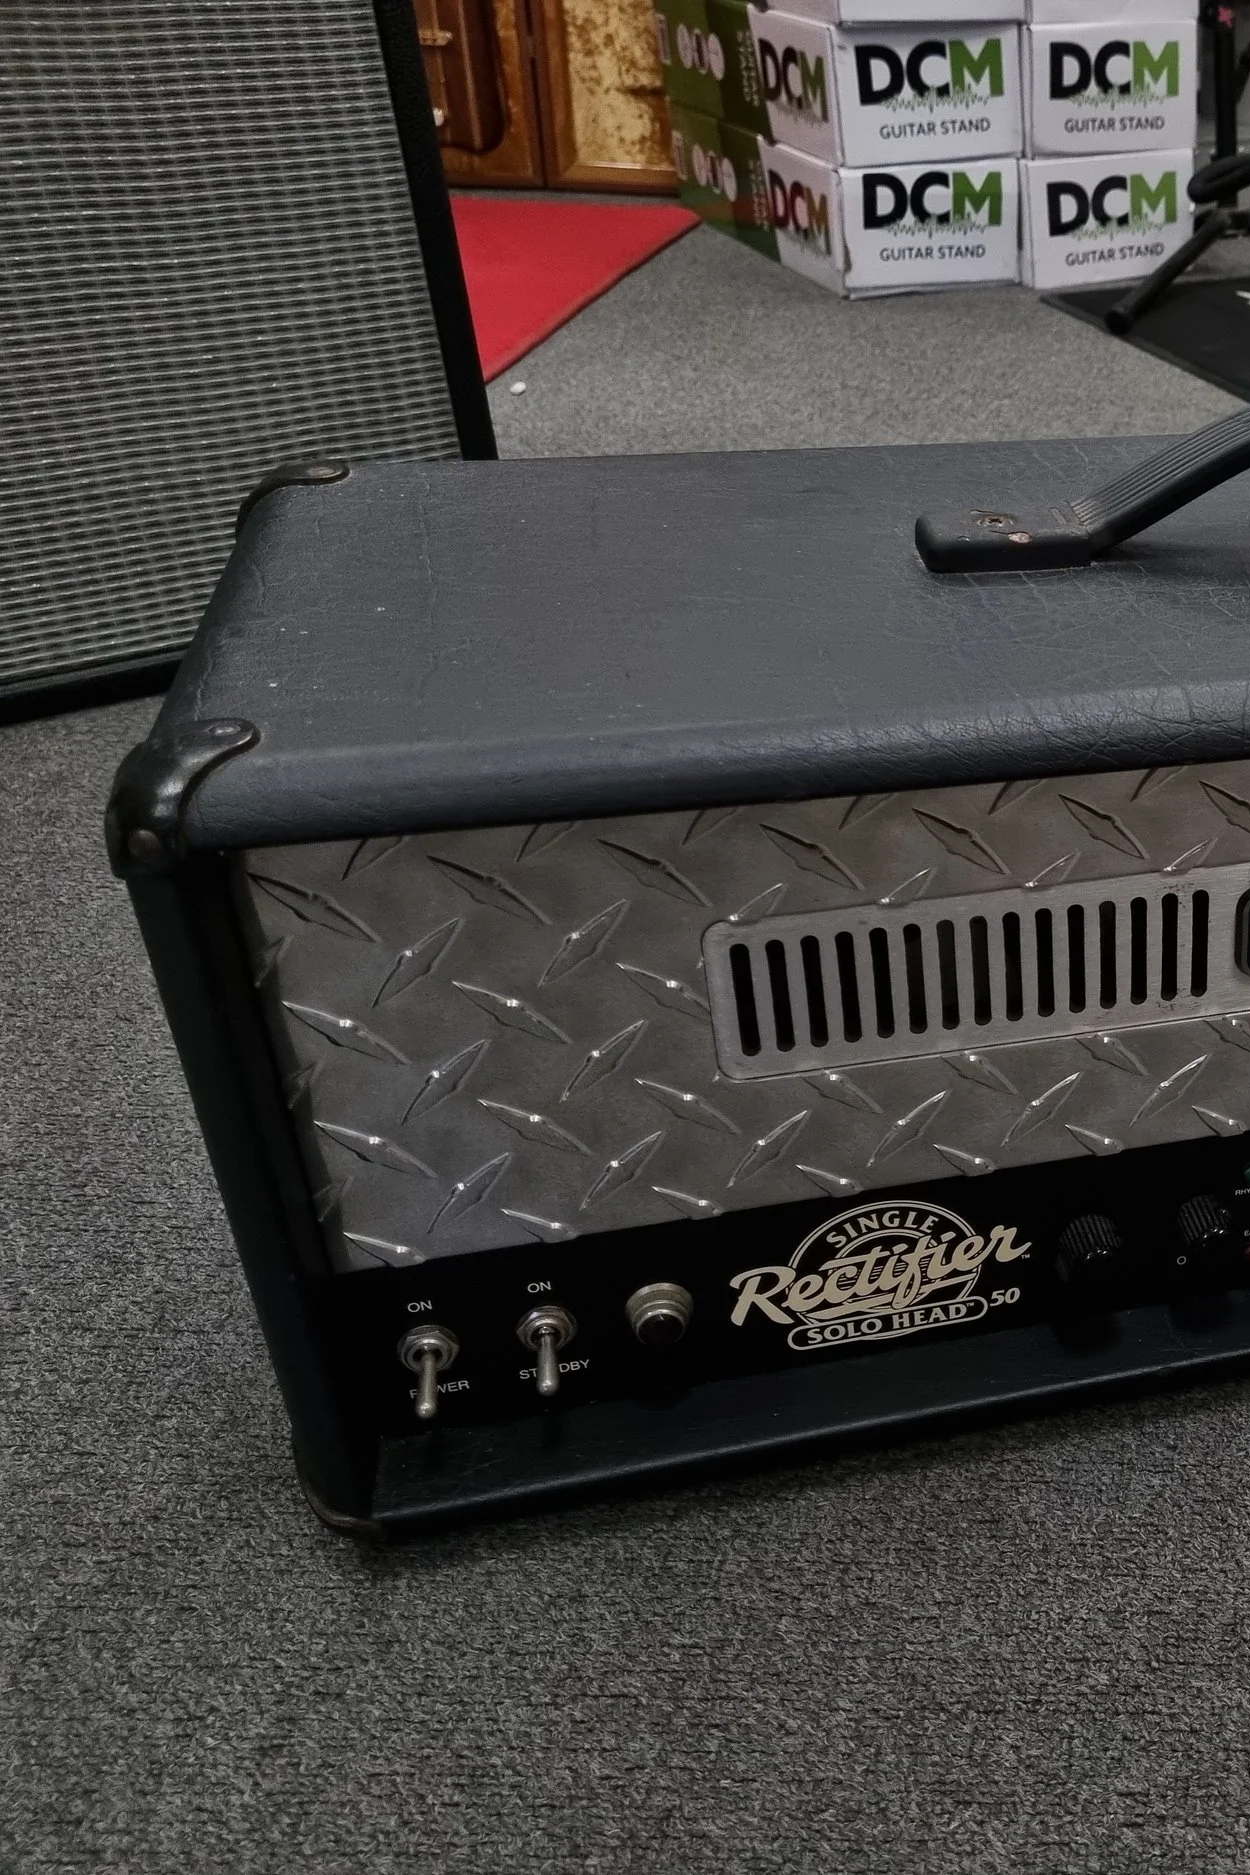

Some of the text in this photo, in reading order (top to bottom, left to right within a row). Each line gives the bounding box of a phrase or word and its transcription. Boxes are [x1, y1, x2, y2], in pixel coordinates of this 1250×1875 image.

[758, 37, 829, 124] DCM
[855, 38, 1004, 106] DCM
[1049, 40, 1180, 101] DCM
[879, 117, 991, 139] GUITAR STAND
[1064, 116, 1166, 133] GUITAR STAND
[768, 168, 832, 257] DCM
[862, 171, 1003, 230] DCM
[1046, 171, 1177, 237] DCM
[880, 243, 987, 262] GUITAR STAND
[1065, 242, 1166, 267] GUITAR STAND
[825, 1210, 940, 1249] SINGLE
[527, 1281, 552, 1294] ON
[728, 1224, 1033, 1327] Rectifier
[407, 1299, 434, 1314] ON
[989, 1287, 1021, 1308] 50
[806, 1318, 883, 1345] SOLO
[891, 1303, 968, 1330] HEAD
[519, 1358, 590, 1380] STDBY
[408, 1380, 470, 1400] PWER
